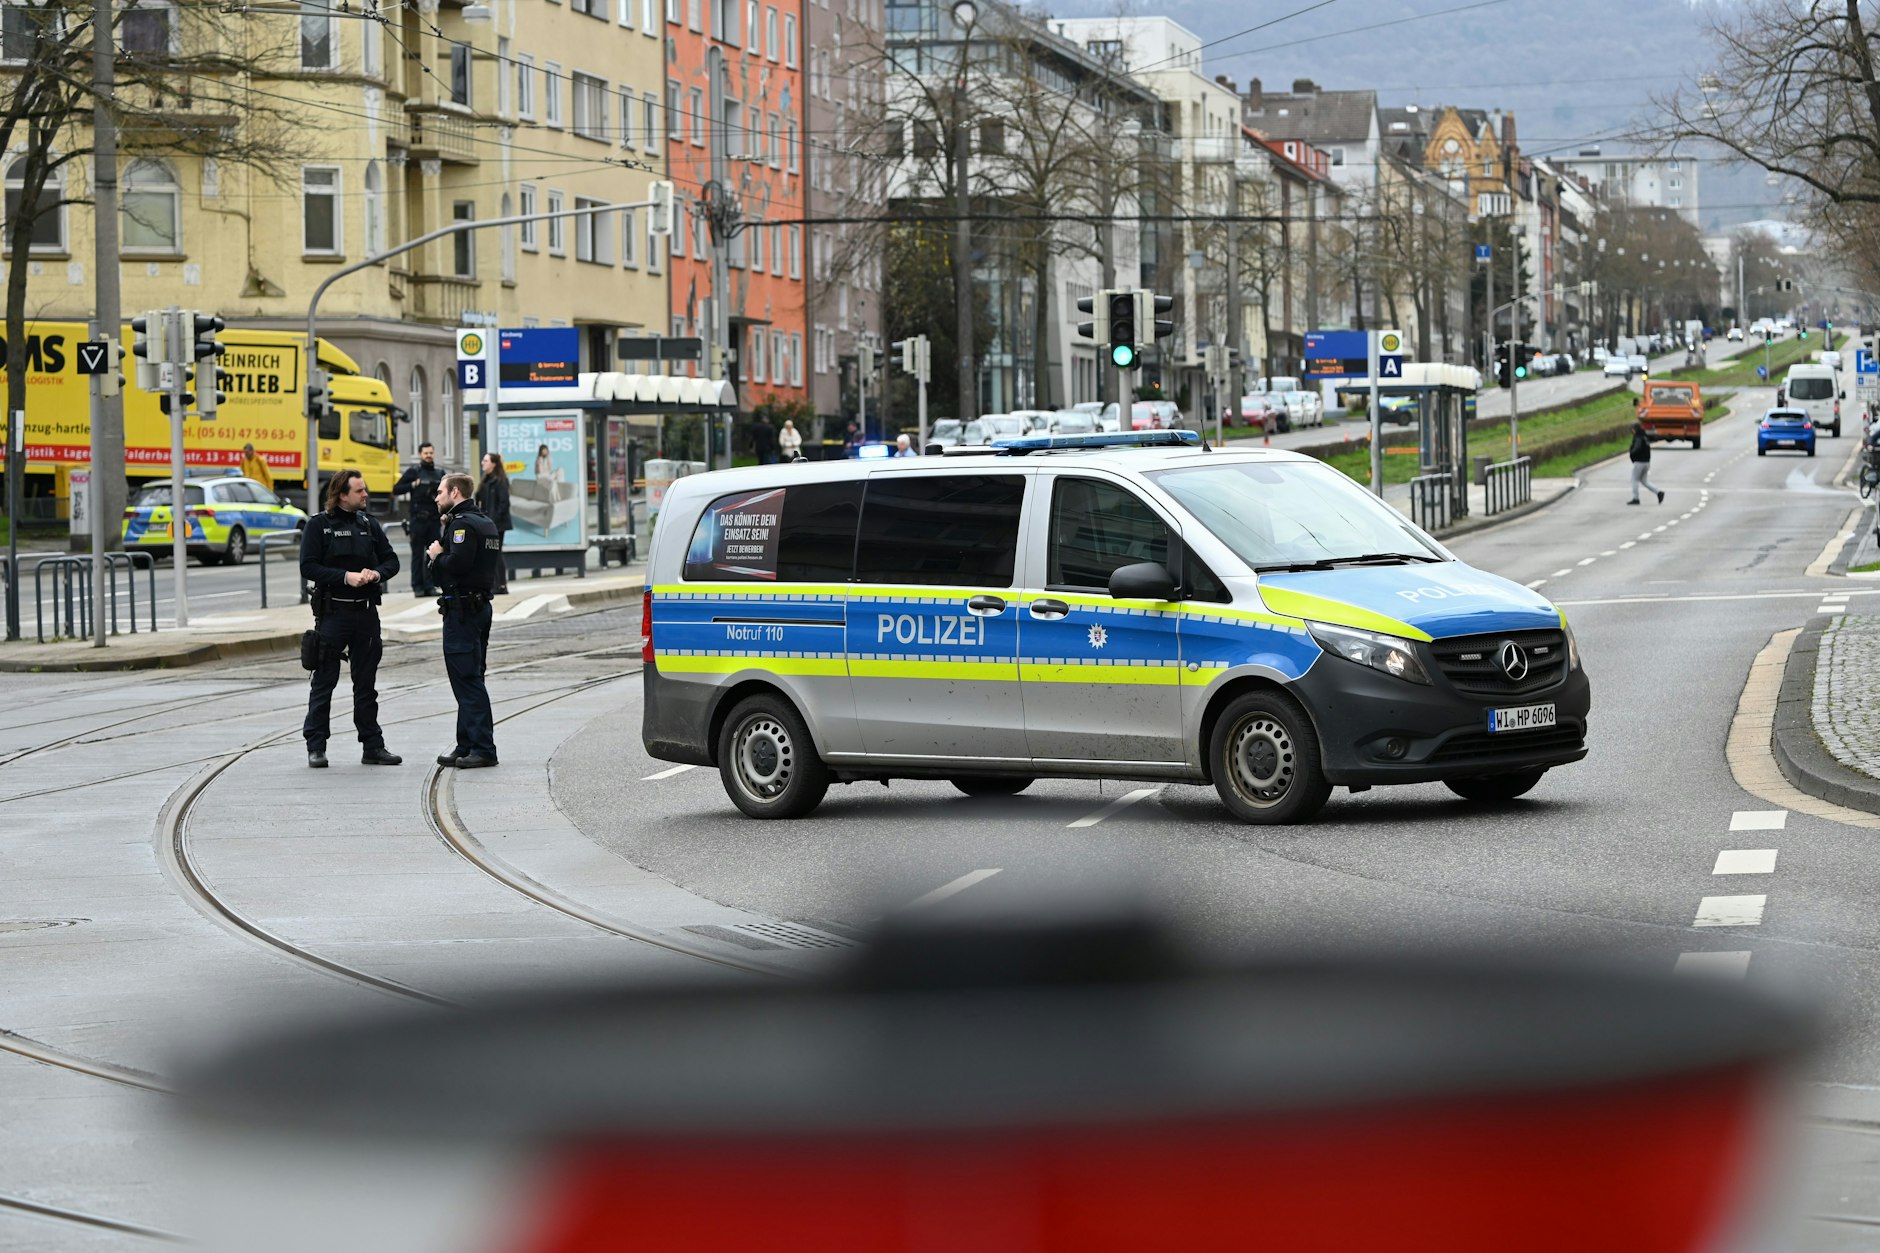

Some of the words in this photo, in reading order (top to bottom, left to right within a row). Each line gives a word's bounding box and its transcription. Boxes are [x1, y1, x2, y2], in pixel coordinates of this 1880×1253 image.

[465, 364, 479, 385] B
[1384, 358, 1398, 375] A
[198, 426, 215, 439] (05
[218, 427, 236, 440] 61)
[238, 428, 252, 439] 47
[255, 429, 269, 440] 59
[271, 429, 296, 440] 63-0
[498, 424, 543, 438] BEST
[720, 514, 734, 527] DAS
[734, 511, 760, 527] KÖNNTE
[760, 514, 777, 527] DEIN
[724, 528, 751, 541] EINSATZ
[751, 528, 770, 541] SEIN!
[726, 624, 763, 641] Notruf
[765, 626, 784, 642] 110
[877, 614, 985, 646] POLIZEI
[1496, 711, 1509, 728] WI
[1517, 709, 1530, 727] HP
[1532, 706, 1554, 725] 6096
